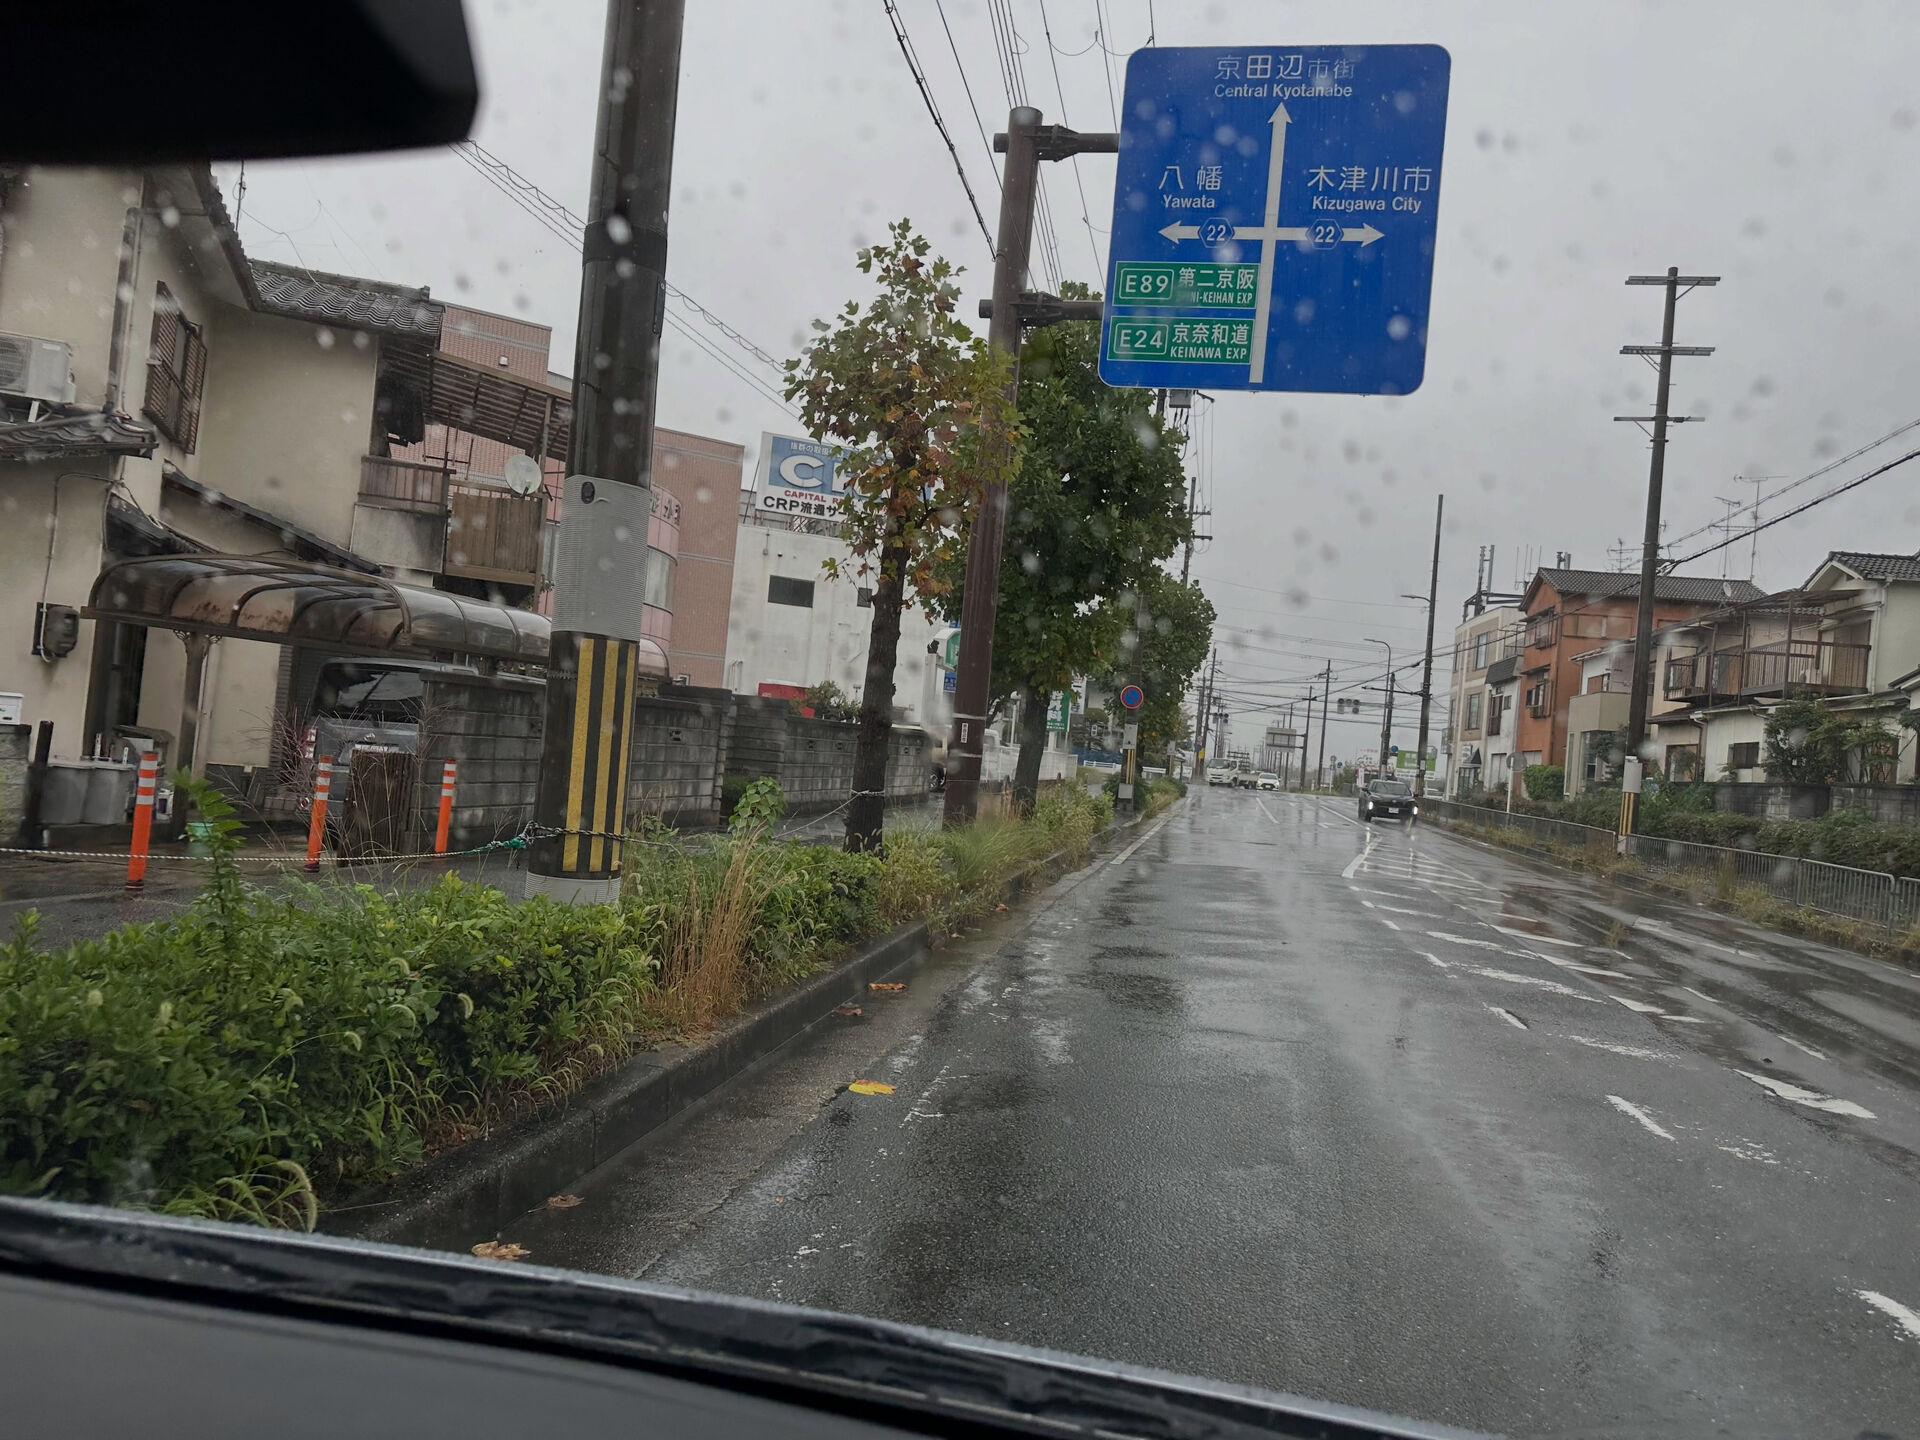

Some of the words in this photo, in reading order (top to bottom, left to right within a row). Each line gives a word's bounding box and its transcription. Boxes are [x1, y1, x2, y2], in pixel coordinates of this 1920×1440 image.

[1214, 55, 1355, 80] 京田辺市街
[1214, 84, 1267, 97] Central
[1272, 84, 1353, 100] Kyotanabe
[1158, 165, 1223, 191] 八幡
[1307, 165, 1432, 192] 木津川市
[1163, 194, 1215, 209] Yawata
[1312, 195, 1385, 213] Kizugawa
[1391, 197, 1422, 214] City
[1206, 225, 1226, 241] 22
[1314, 226, 1335, 244] 22
[1125, 274, 1169, 293] E89
[1178, 267, 1255, 290] 第二京阪
[1184, 291, 1233, 304] NI-KEIHAN
[1236, 292, 1252, 304] EXP
[1119, 329, 1163, 349] E24
[1172, 323, 1249, 345] 京奈和道
[1170, 346, 1222, 359] KEINAWA
[1226, 347, 1247, 359] EXP
[784, 489, 826, 503] CAPITAL
